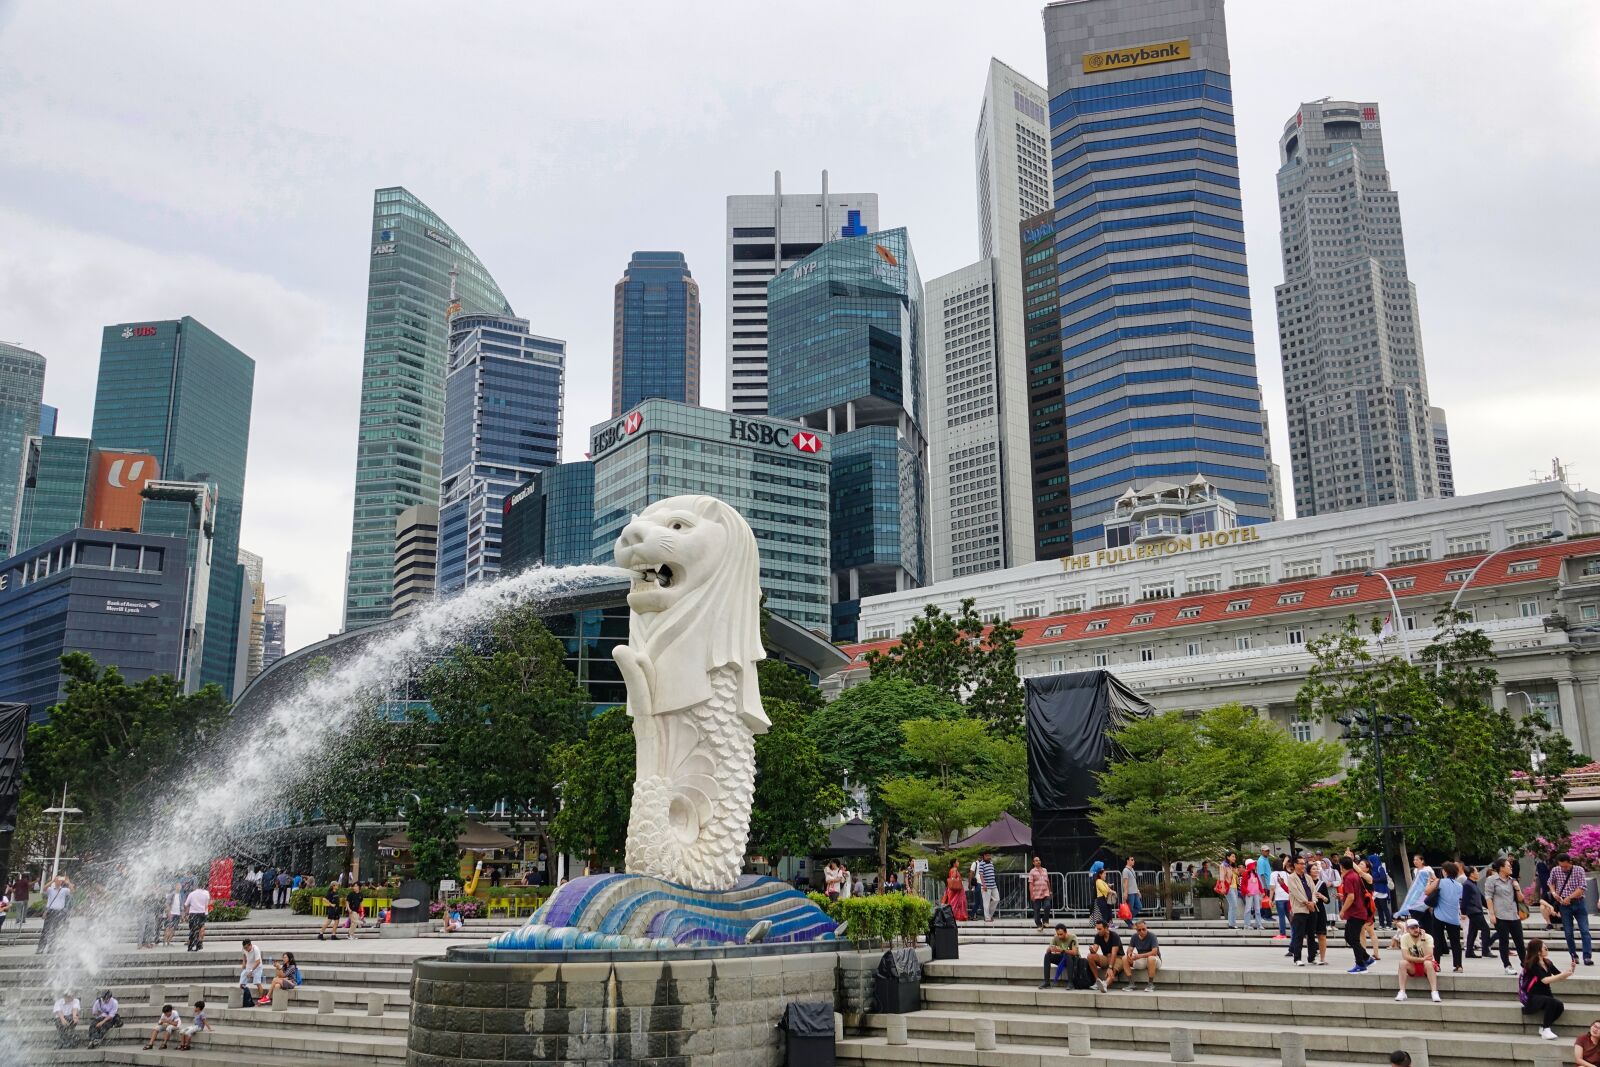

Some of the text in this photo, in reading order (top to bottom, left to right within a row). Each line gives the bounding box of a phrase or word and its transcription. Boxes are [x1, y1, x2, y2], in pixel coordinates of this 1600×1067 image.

[1105, 44, 1180, 65] Maybank
[1360, 122, 1381, 130] UOB
[373, 244, 396, 255] ANZ
[793, 261, 817, 279] MYP
[133, 327, 157, 337] UBS
[592, 419, 626, 456] HSBC
[729, 418, 790, 449] HSBC
[1061, 526, 1260, 572] THE FULLERTON HOTEL
